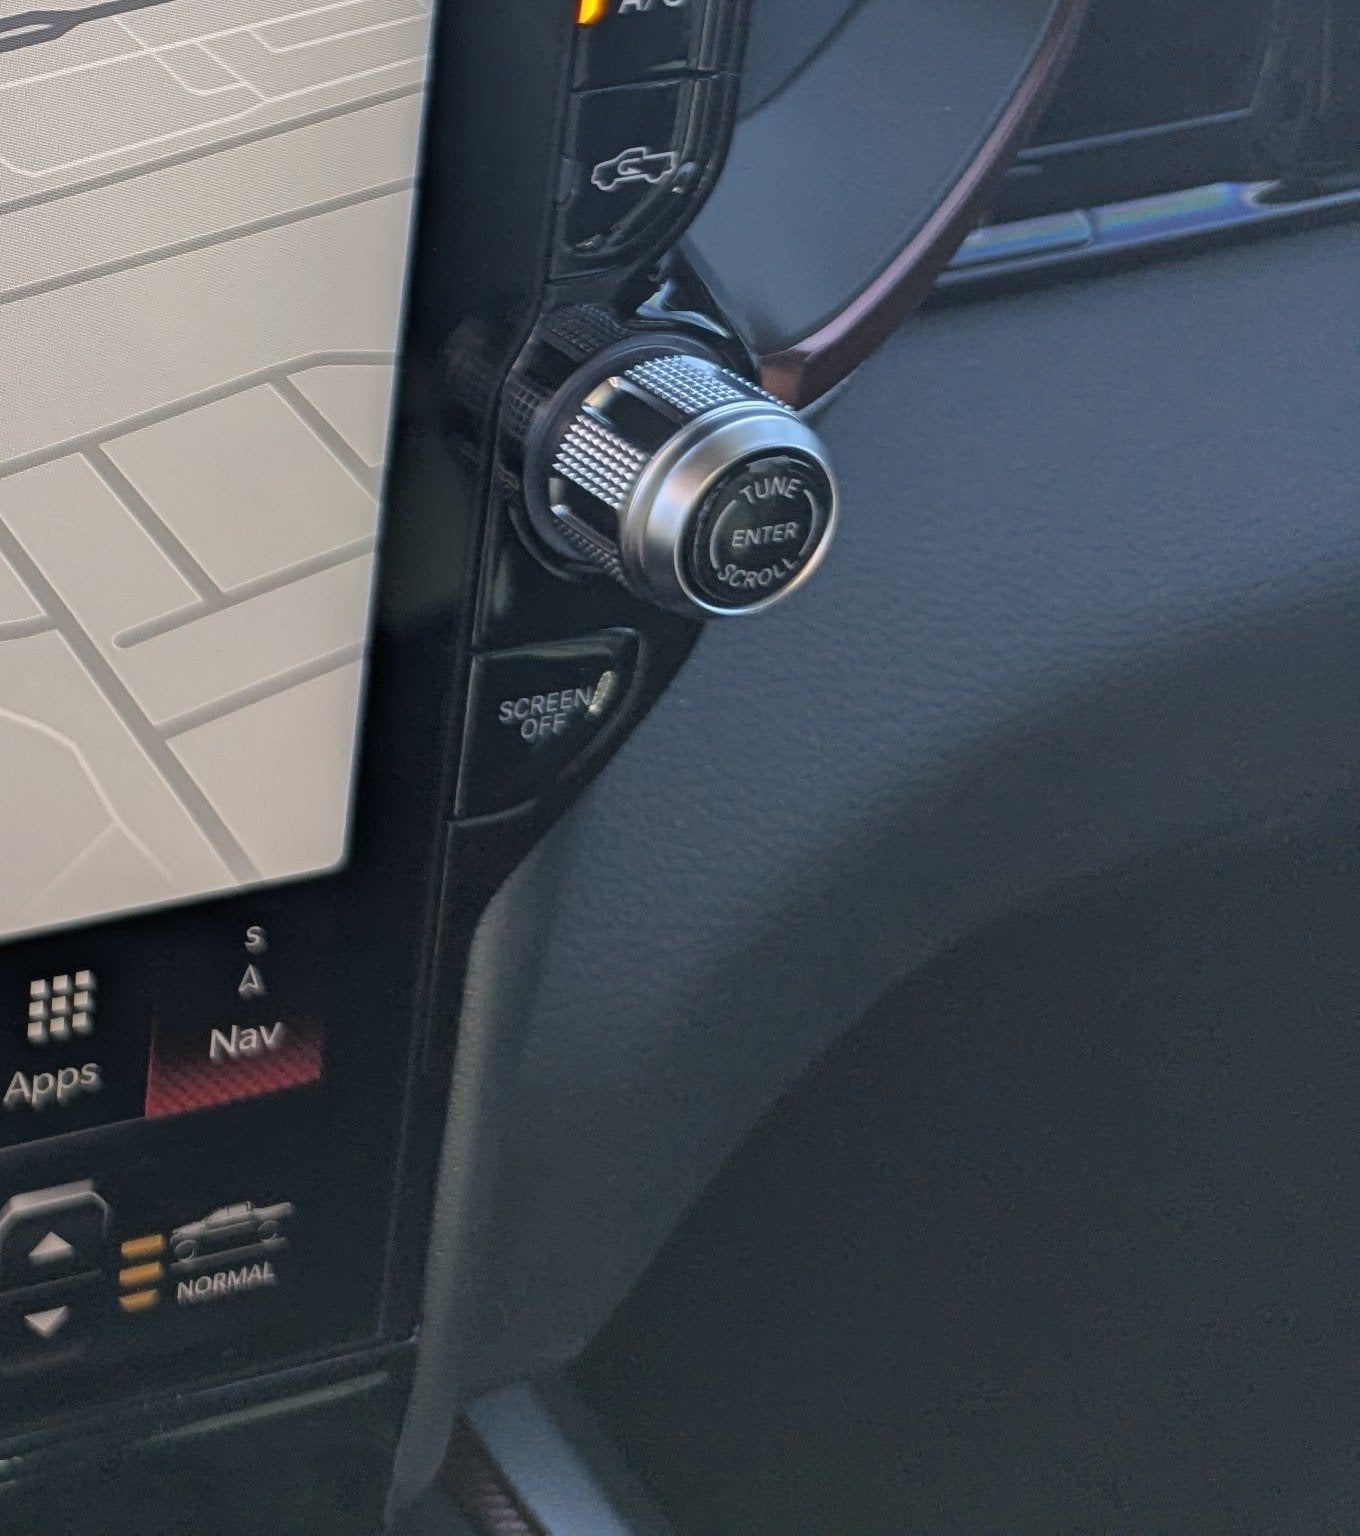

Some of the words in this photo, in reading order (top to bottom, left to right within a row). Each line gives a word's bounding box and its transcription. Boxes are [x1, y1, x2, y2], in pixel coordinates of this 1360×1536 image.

[738, 476, 802, 506] TUNE
[731, 520, 800, 549] ENTER
[716, 557, 799, 590] SCROLL
[498, 688, 593, 724] SCREEN
[520, 712, 568, 741] OFF
[208, 1020, 284, 1061] Nav
[3, 1060, 101, 1109] Apps
[176, 1260, 275, 1302] NORMAL
